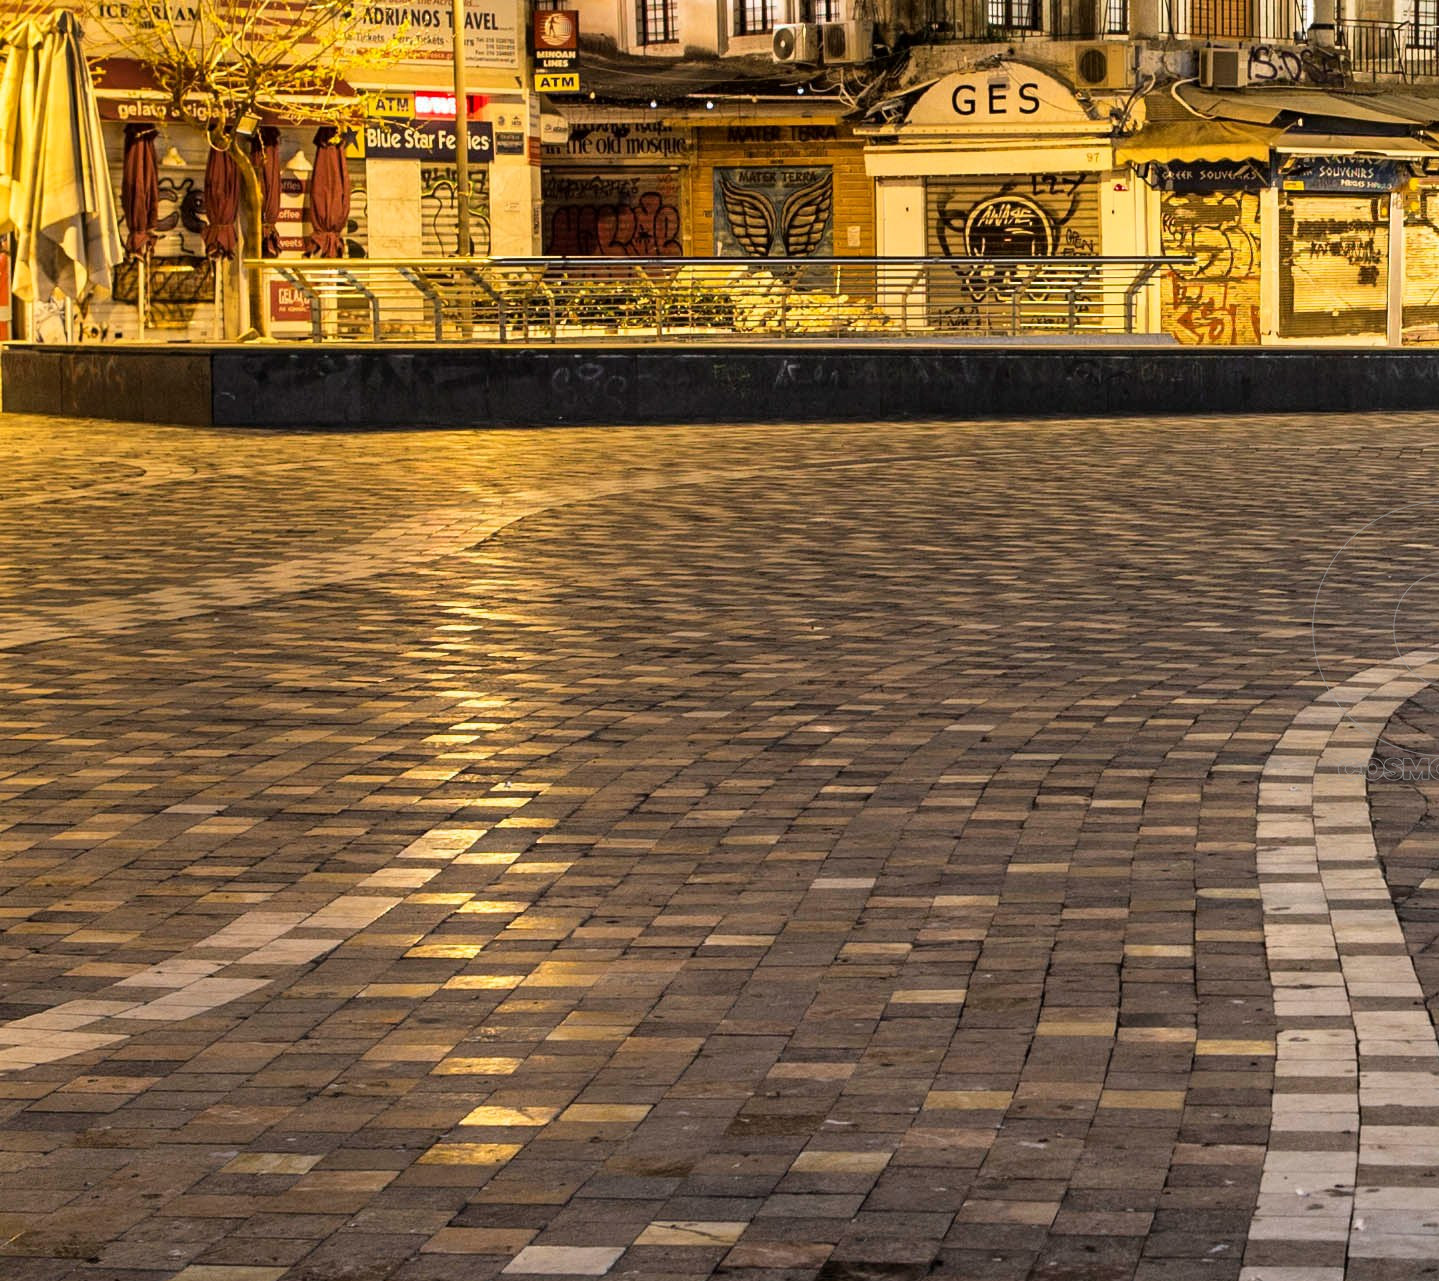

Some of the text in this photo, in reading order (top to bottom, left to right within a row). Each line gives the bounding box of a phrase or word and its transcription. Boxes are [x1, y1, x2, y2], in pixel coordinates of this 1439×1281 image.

[363, 7, 499, 31] ADRIANOS TAVEL
[536, 50, 576, 60] MINOAN
[543, 60, 569, 69] LINES
[539, 76, 575, 89] ATM
[375, 98, 409, 111] ATM
[951, 82, 1040, 115] GES
[367, 128, 402, 149] Blue
[404, 129, 436, 150] Star
[597, 135, 621, 154] old
[626, 135, 687, 158] mosque
[1086, 152, 1101, 163] 97
[738, 171, 817, 183] MATER TERRA
[1319, 165, 1375, 179] SOUVENIRS
